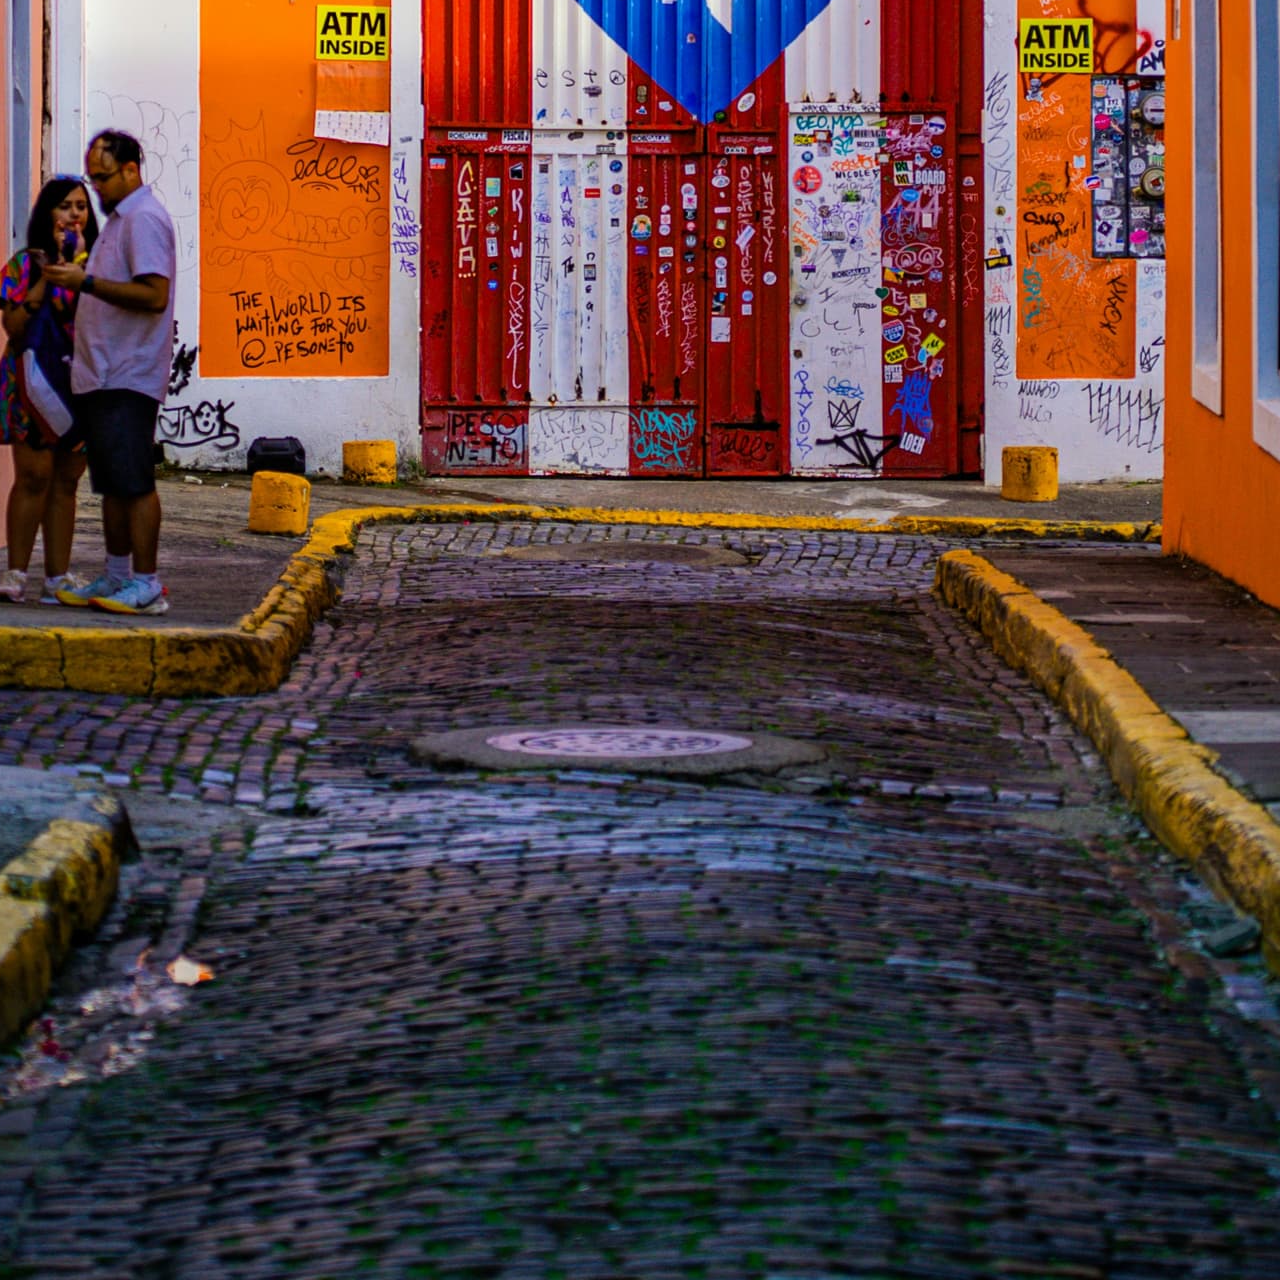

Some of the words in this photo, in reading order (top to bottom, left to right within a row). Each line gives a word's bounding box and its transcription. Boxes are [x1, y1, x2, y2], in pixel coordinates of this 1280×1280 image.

[320, 12, 386, 37] ATM
[320, 40, 385, 56] INSIDE
[1023, 25, 1090, 49] ATM
[1023, 53, 1089, 68] INSIDE
[915, 170, 945, 185] BOARD
[230, 291, 262, 312] THE
[270, 292, 332, 322] WORLD
[337, 296, 365, 316] IS
[310, 319, 337, 332] FOR
[452, 413, 518, 436] PESO
[448, 436, 518, 462] NETO
